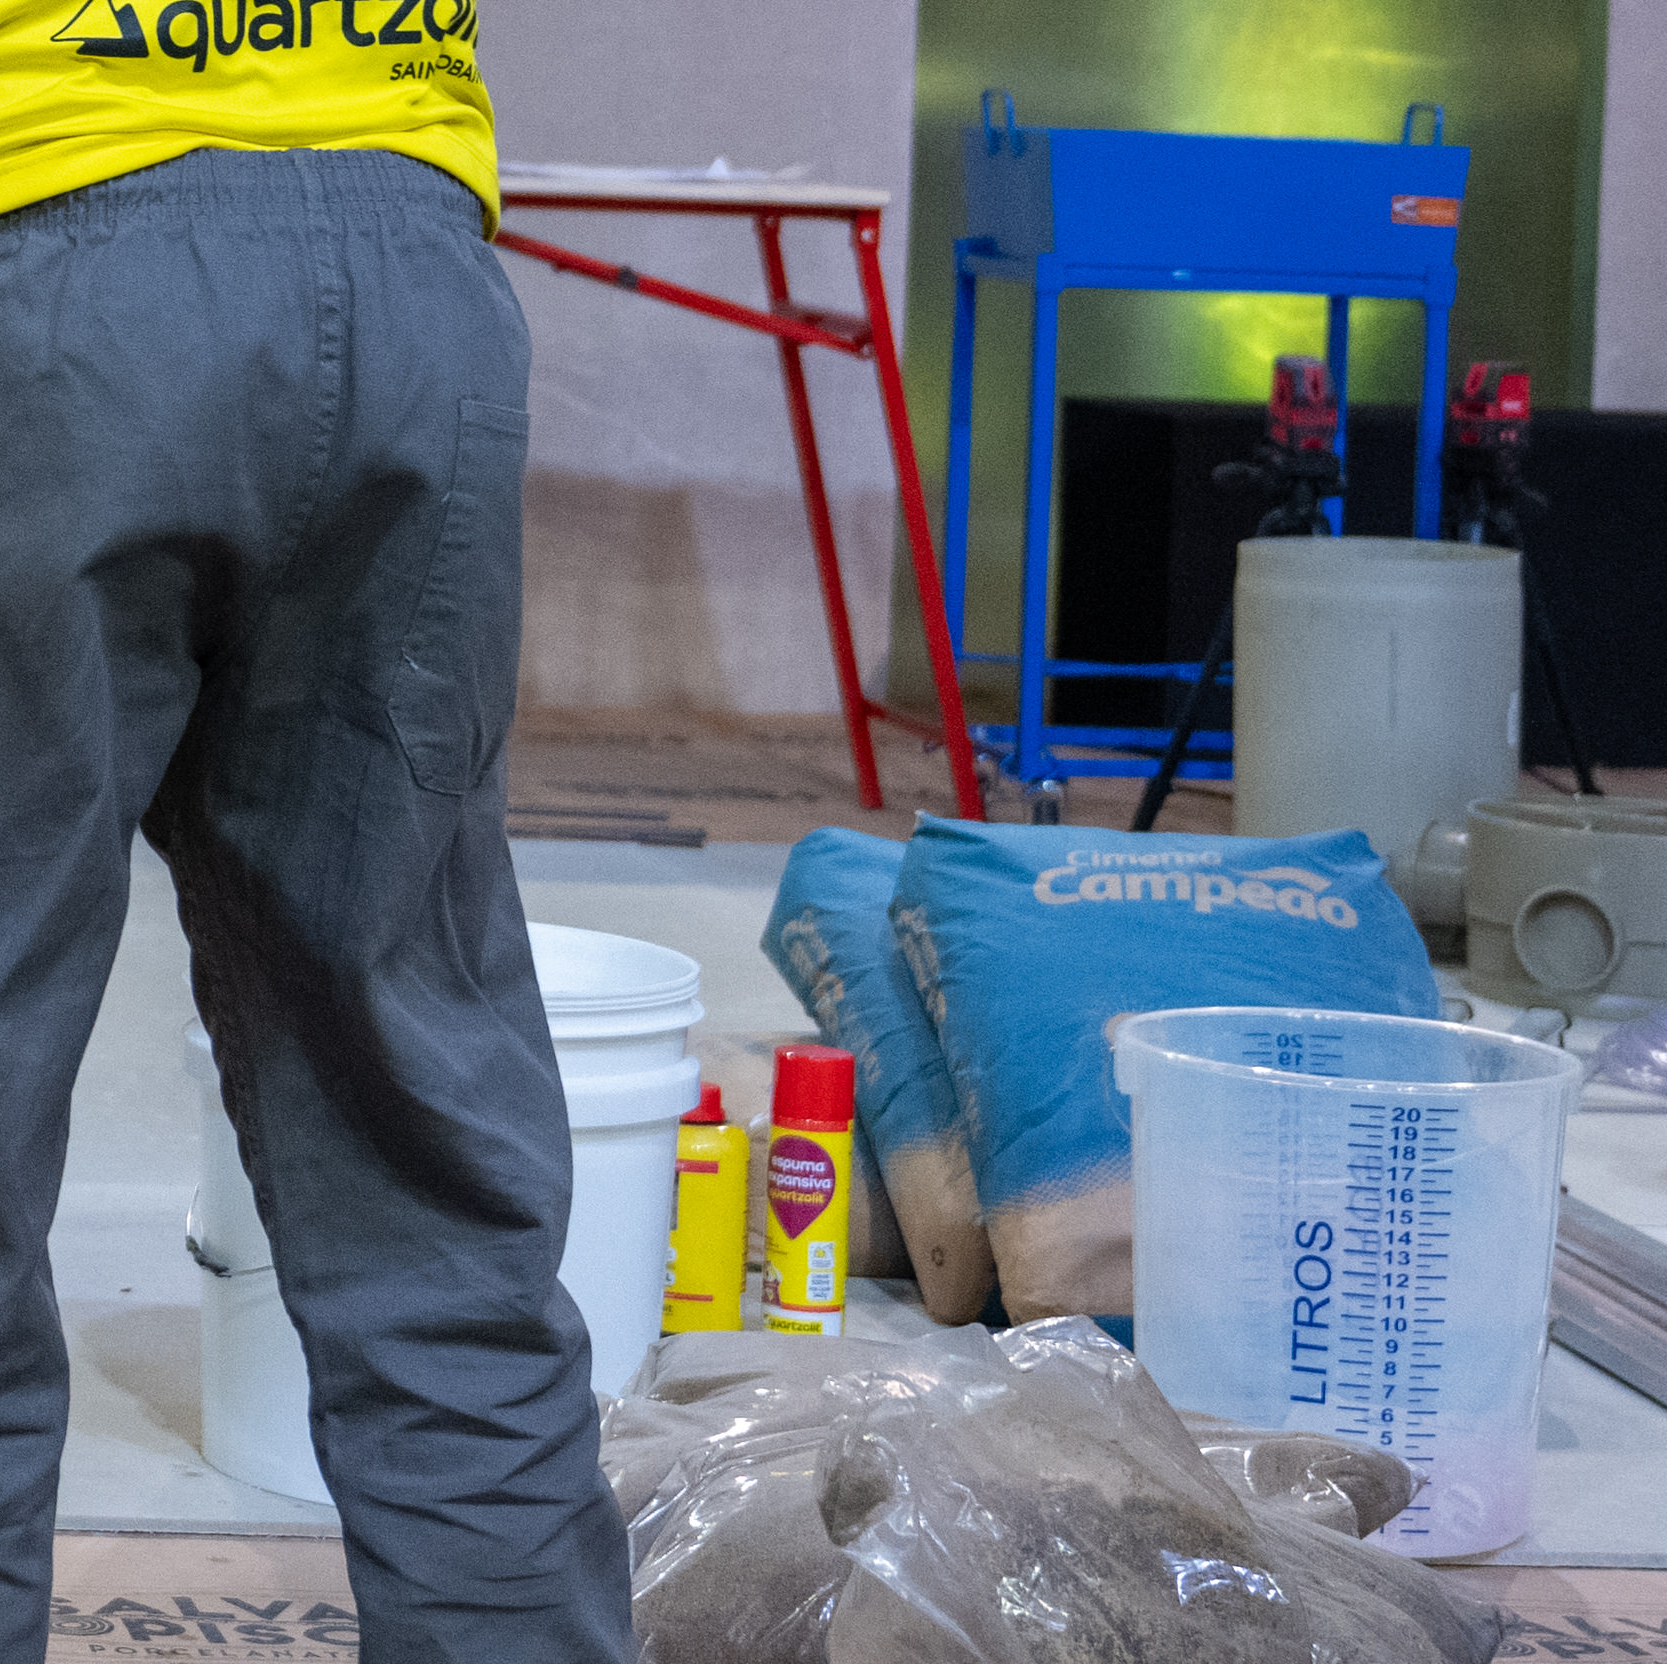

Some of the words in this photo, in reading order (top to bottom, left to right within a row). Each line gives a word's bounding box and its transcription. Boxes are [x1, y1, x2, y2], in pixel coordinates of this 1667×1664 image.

[1032, 866, 1359, 930] Campeão
[1391, 1107, 1422, 1123] 20
[1390, 1126, 1419, 1142] 19
[1388, 1145, 1417, 1162] 18
[1386, 1166, 1416, 1182] 17
[1386, 1188, 1415, 1204] 16
[1385, 1209, 1414, 1225] 15
[1384, 1230, 1413, 1246] 14
[1383, 1250, 1412, 1266] 13
[1382, 1272, 1410, 1288] 12
[1382, 1294, 1407, 1310] 11
[1289, 1219, 1334, 1405] LITROS
[1381, 1316, 1408, 1333] 10
[1385, 1339, 1399, 1354] 9
[1383, 1361, 1398, 1376] 8
[1382, 1384, 1396, 1399] 7
[1380, 1408, 1395, 1423] 6
[1380, 1431, 1394, 1446] 5
